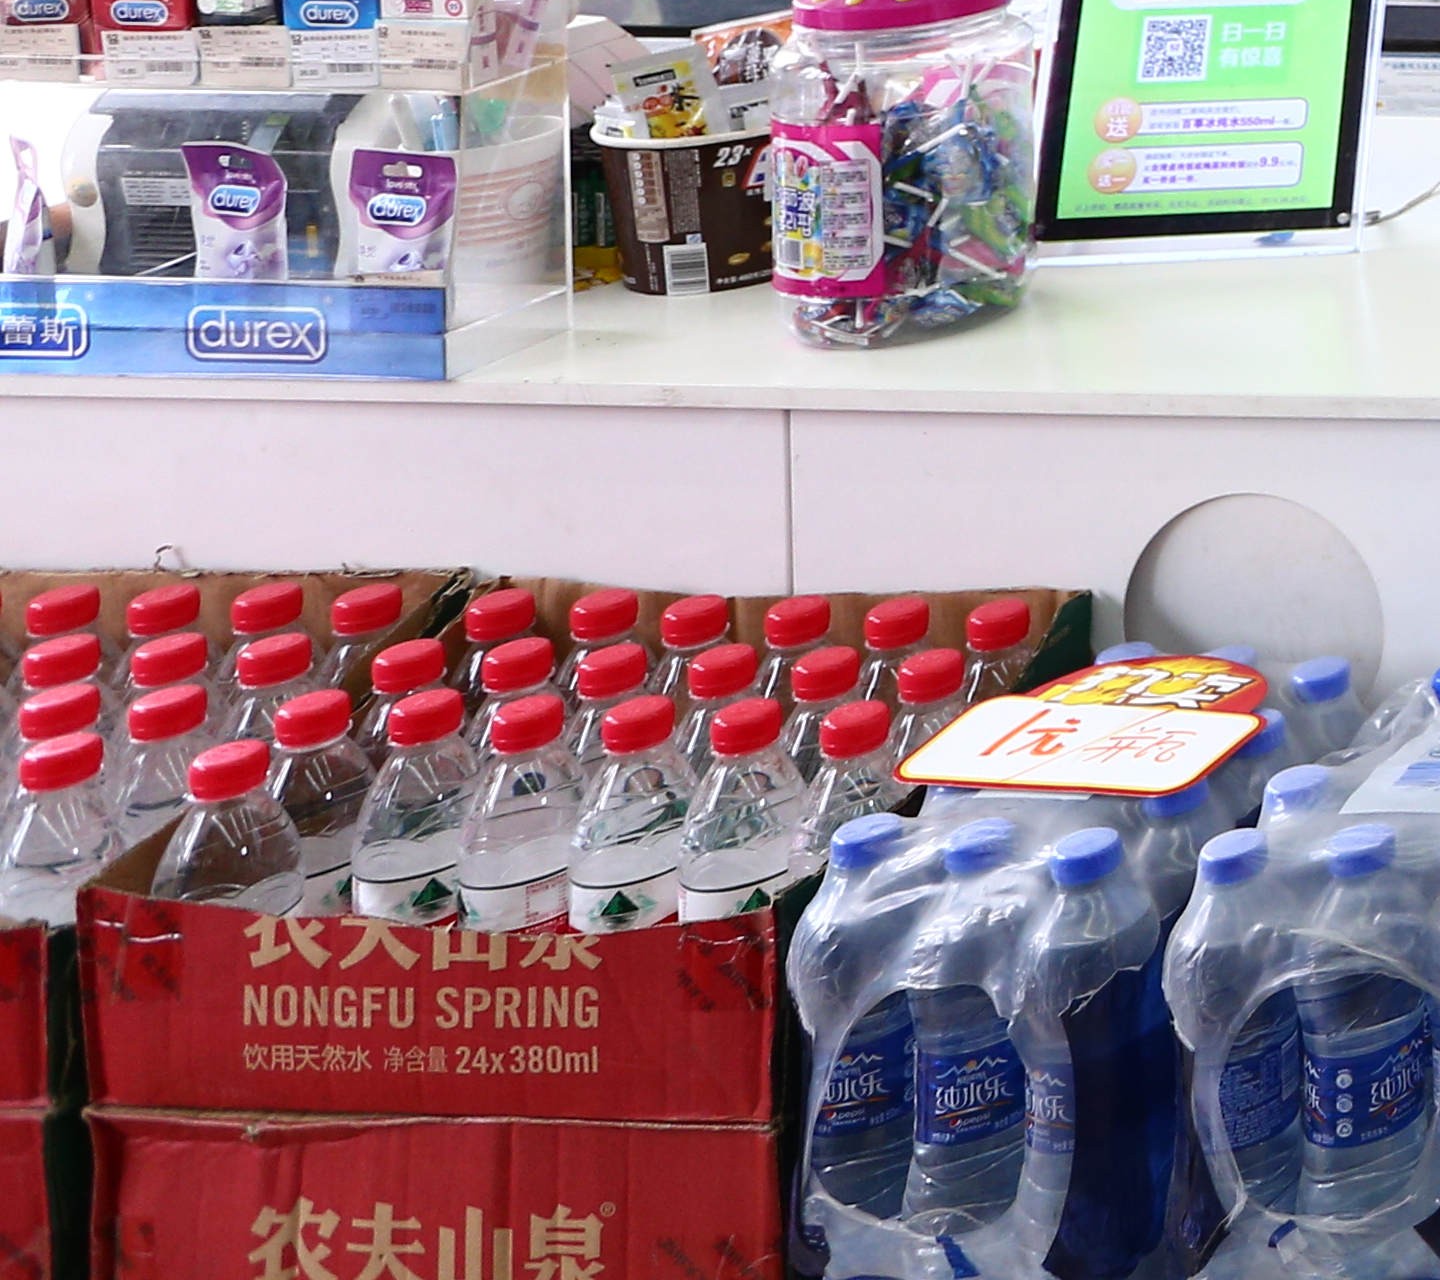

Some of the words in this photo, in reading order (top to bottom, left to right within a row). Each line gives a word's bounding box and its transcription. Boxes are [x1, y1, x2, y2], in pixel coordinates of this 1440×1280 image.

[212, 189, 260, 210] durex
[198, 309, 321, 356] durex
[242, 985, 416, 1029] NONGFU
[435, 985, 601, 1029] SPRING
[242, 1043, 373, 1073] 饮用天然水
[382, 1044, 448, 1073] 净含量
[454, 1044, 600, 1075] 24x380ml
[249, 1199, 606, 1280] 农夫山泉
